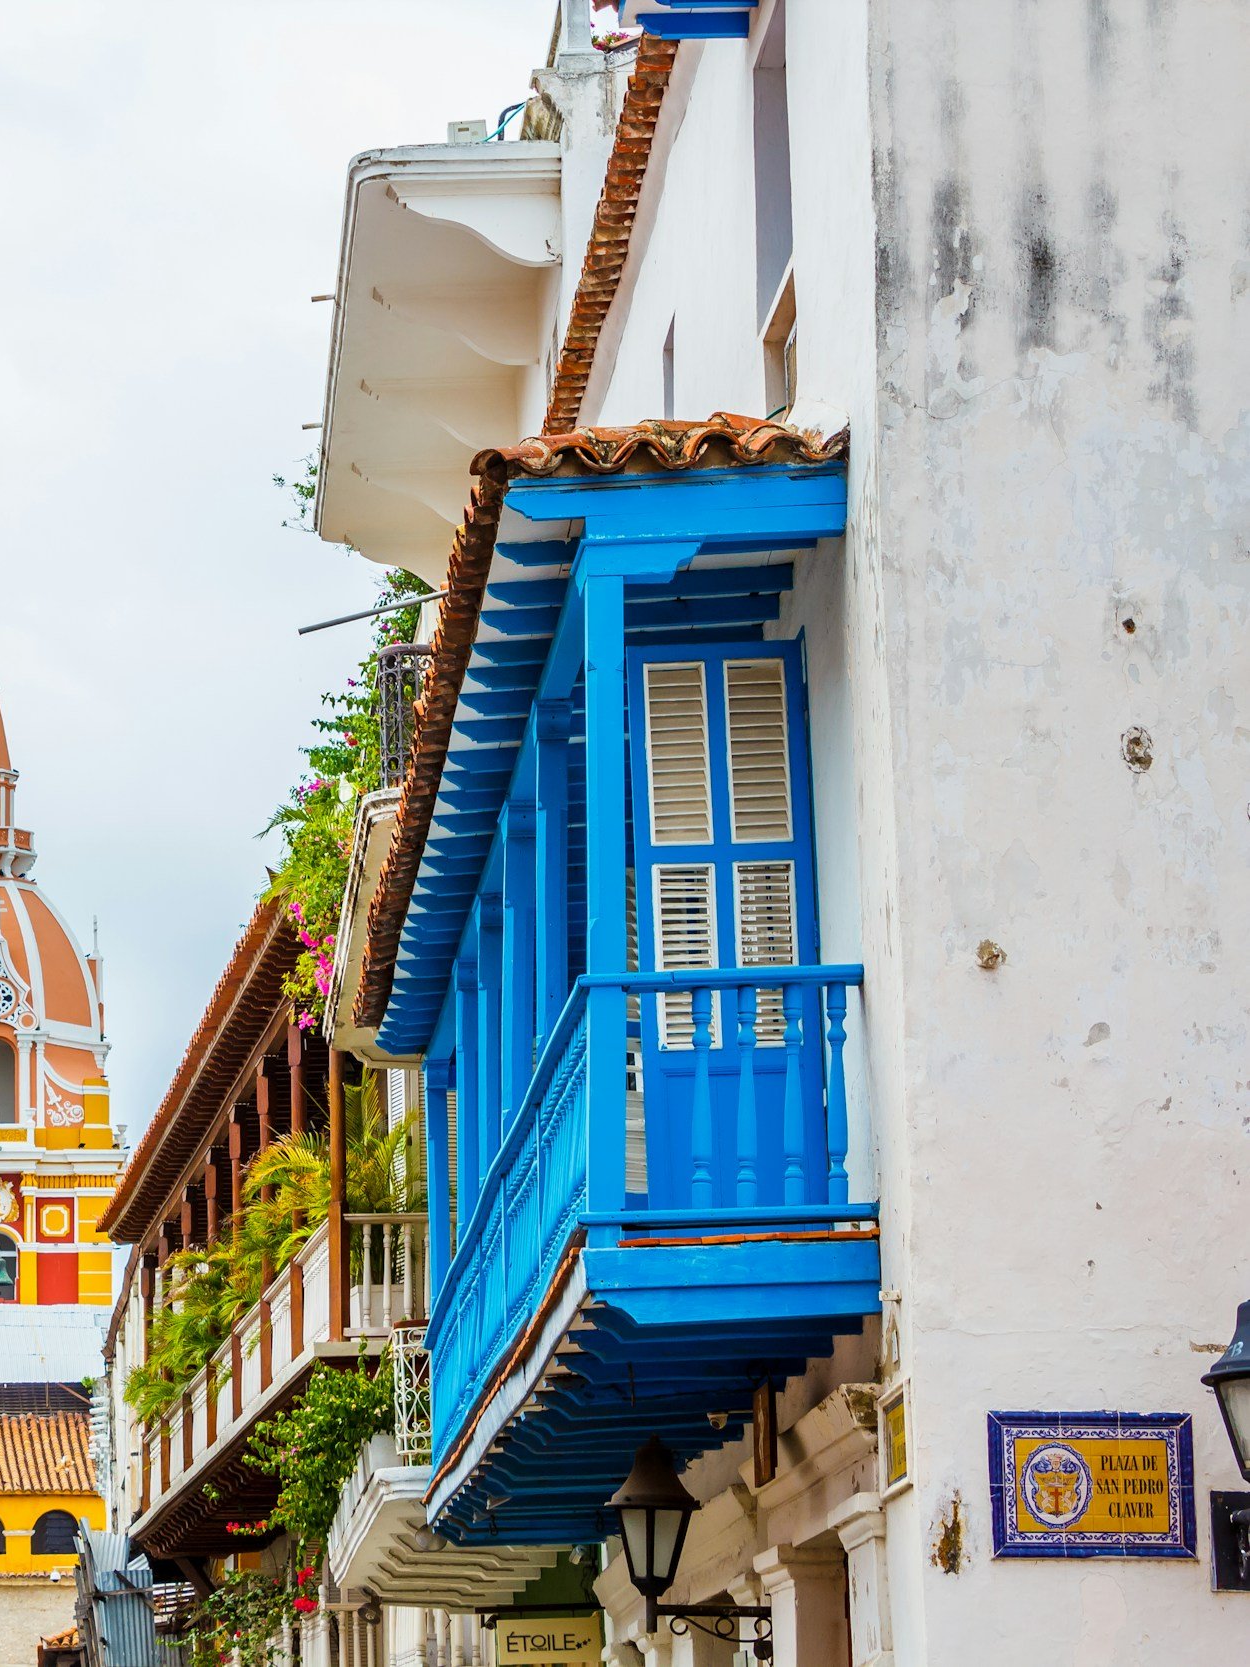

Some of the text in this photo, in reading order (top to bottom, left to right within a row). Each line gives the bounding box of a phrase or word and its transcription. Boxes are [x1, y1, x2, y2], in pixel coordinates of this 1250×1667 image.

[1100, 1454, 1158, 1470] PLAZA DE
[1095, 1478, 1163, 1494] SAN PEDRO
[1107, 1501, 1154, 1518] CLAVER
[506, 1631, 576, 1652] ÉTOILE
